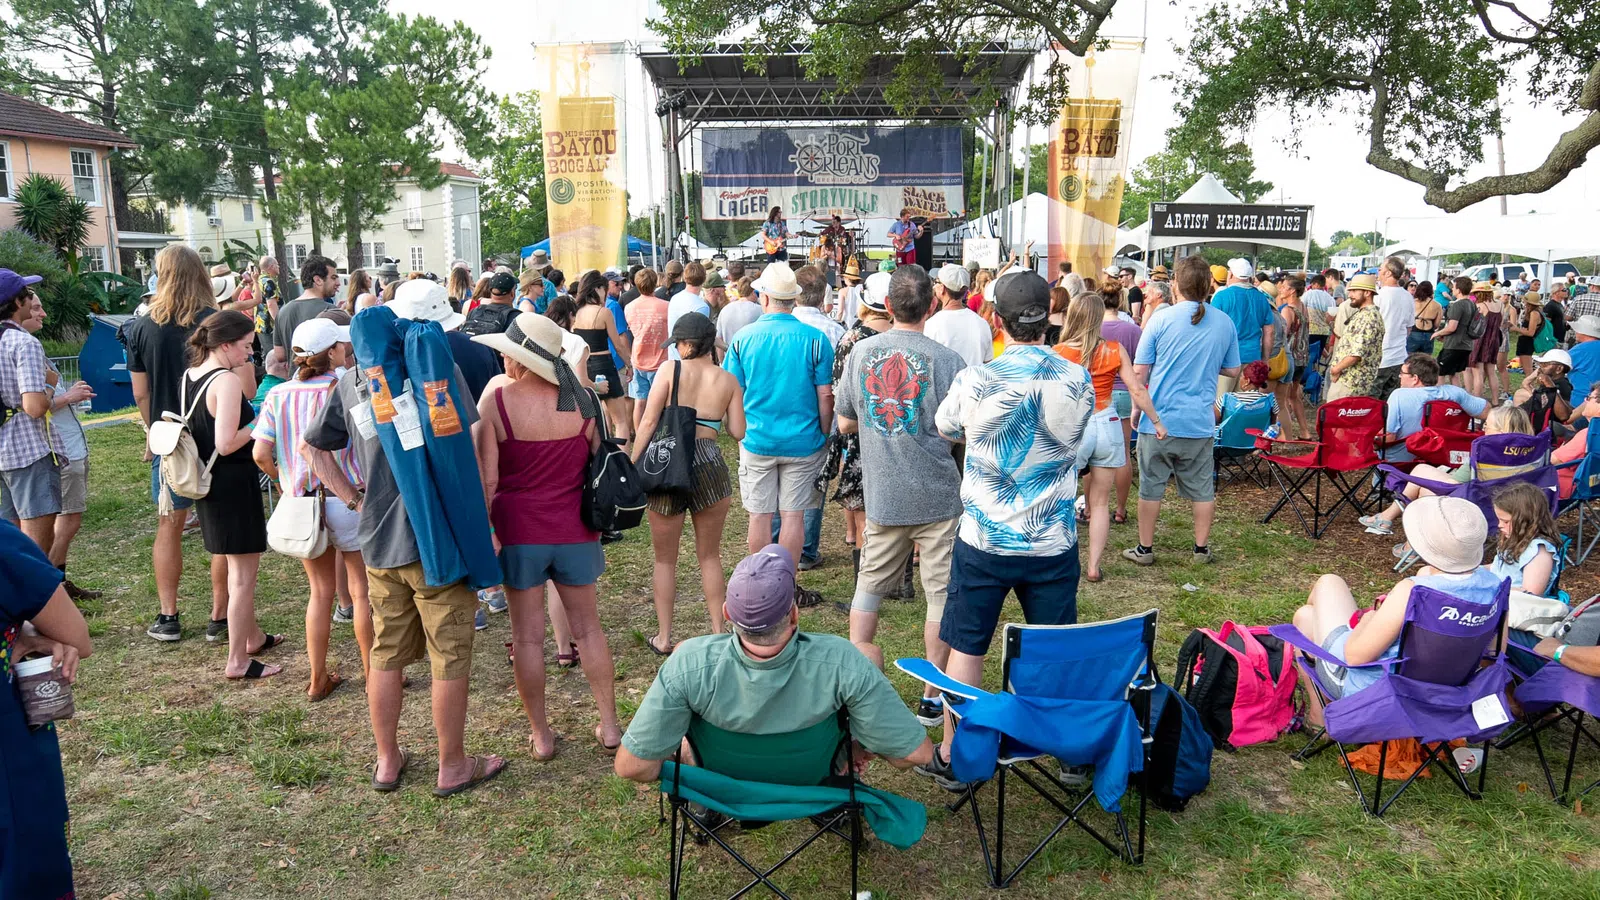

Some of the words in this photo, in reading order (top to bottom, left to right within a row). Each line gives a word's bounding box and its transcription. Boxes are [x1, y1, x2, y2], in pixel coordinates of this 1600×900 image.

[545, 130, 617, 157] BAYOU
[826, 132, 870, 158] PORT
[547, 157, 618, 174] BOOGAL
[577, 180, 616, 188] POSITIV
[791, 187, 879, 215] STORYVILLE
[903, 186, 946, 203] SLACK
[718, 195, 769, 217] LAGER
[903, 197, 948, 213] WATER
[1164, 213, 1209, 229] ARTIST
[1216, 214, 1301, 231] MERCHANDISE
[1503, 446, 1520, 456] LSU
